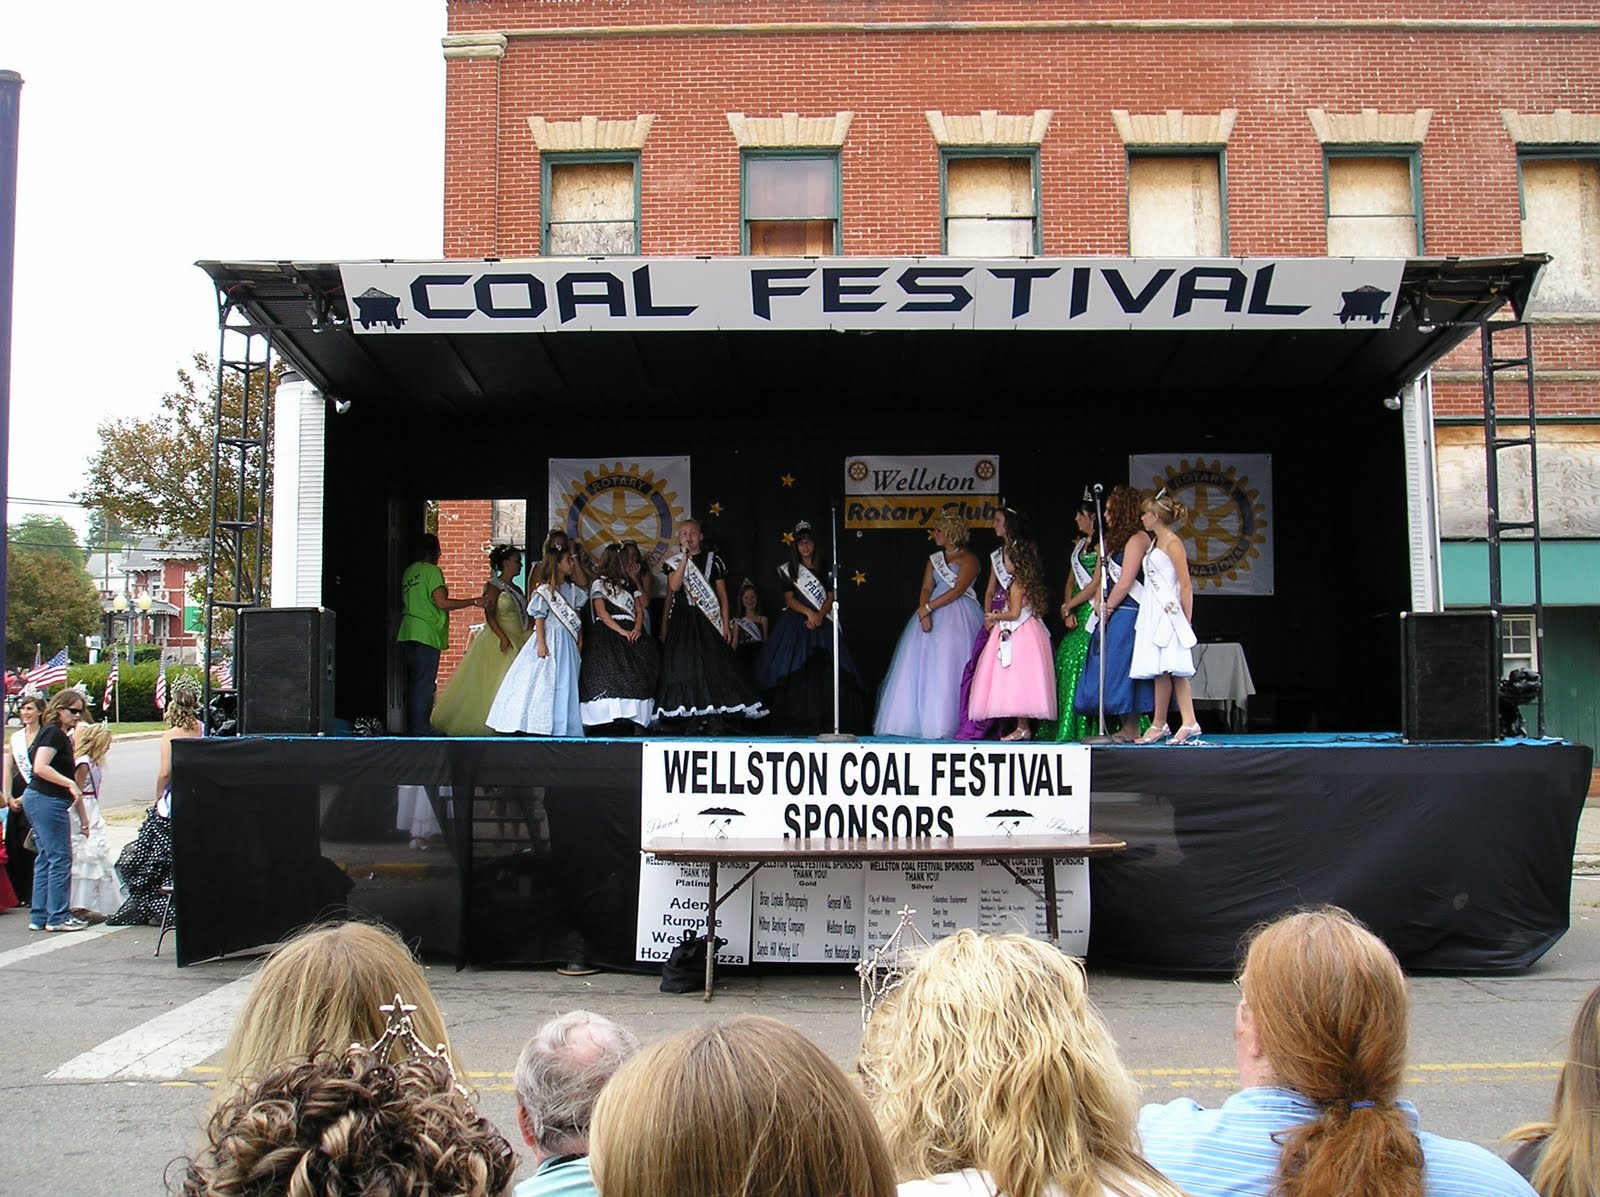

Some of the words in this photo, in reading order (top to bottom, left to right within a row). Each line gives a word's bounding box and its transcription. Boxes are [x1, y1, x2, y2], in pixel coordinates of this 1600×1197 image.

[409, 264, 699, 323] COAL
[750, 262, 1313, 322] FESTIVAL
[590, 477, 645, 492] ROTARY
[872, 467, 976, 491] Wellston
[1174, 472, 1225, 486] ROTARY
[847, 502, 936, 526] Rotary
[804, 580, 825, 605] PRINC
[663, 750, 828, 796] WELLSTON
[840, 752, 919, 797] COAL
[931, 752, 1073, 797] FESTIVAL
[783, 803, 954, 838] SPONSORS
[761, 860, 788, 869] ELLSTON
[869, 861, 901, 871] WELLSTON
[900, 862, 916, 872] COAL
[916, 862, 944, 872] FESTIVAL
[944, 862, 975, 872] SPONSORS
[1015, 867, 1036, 876] THANK
[680, 868, 701, 877] THANK
[793, 869, 813, 879] THANK
[905, 872, 925, 881] THANK
[675, 879, 719, 888] Platinu
[669, 897, 710, 912] Aden
[713, 954, 744, 964] izza
